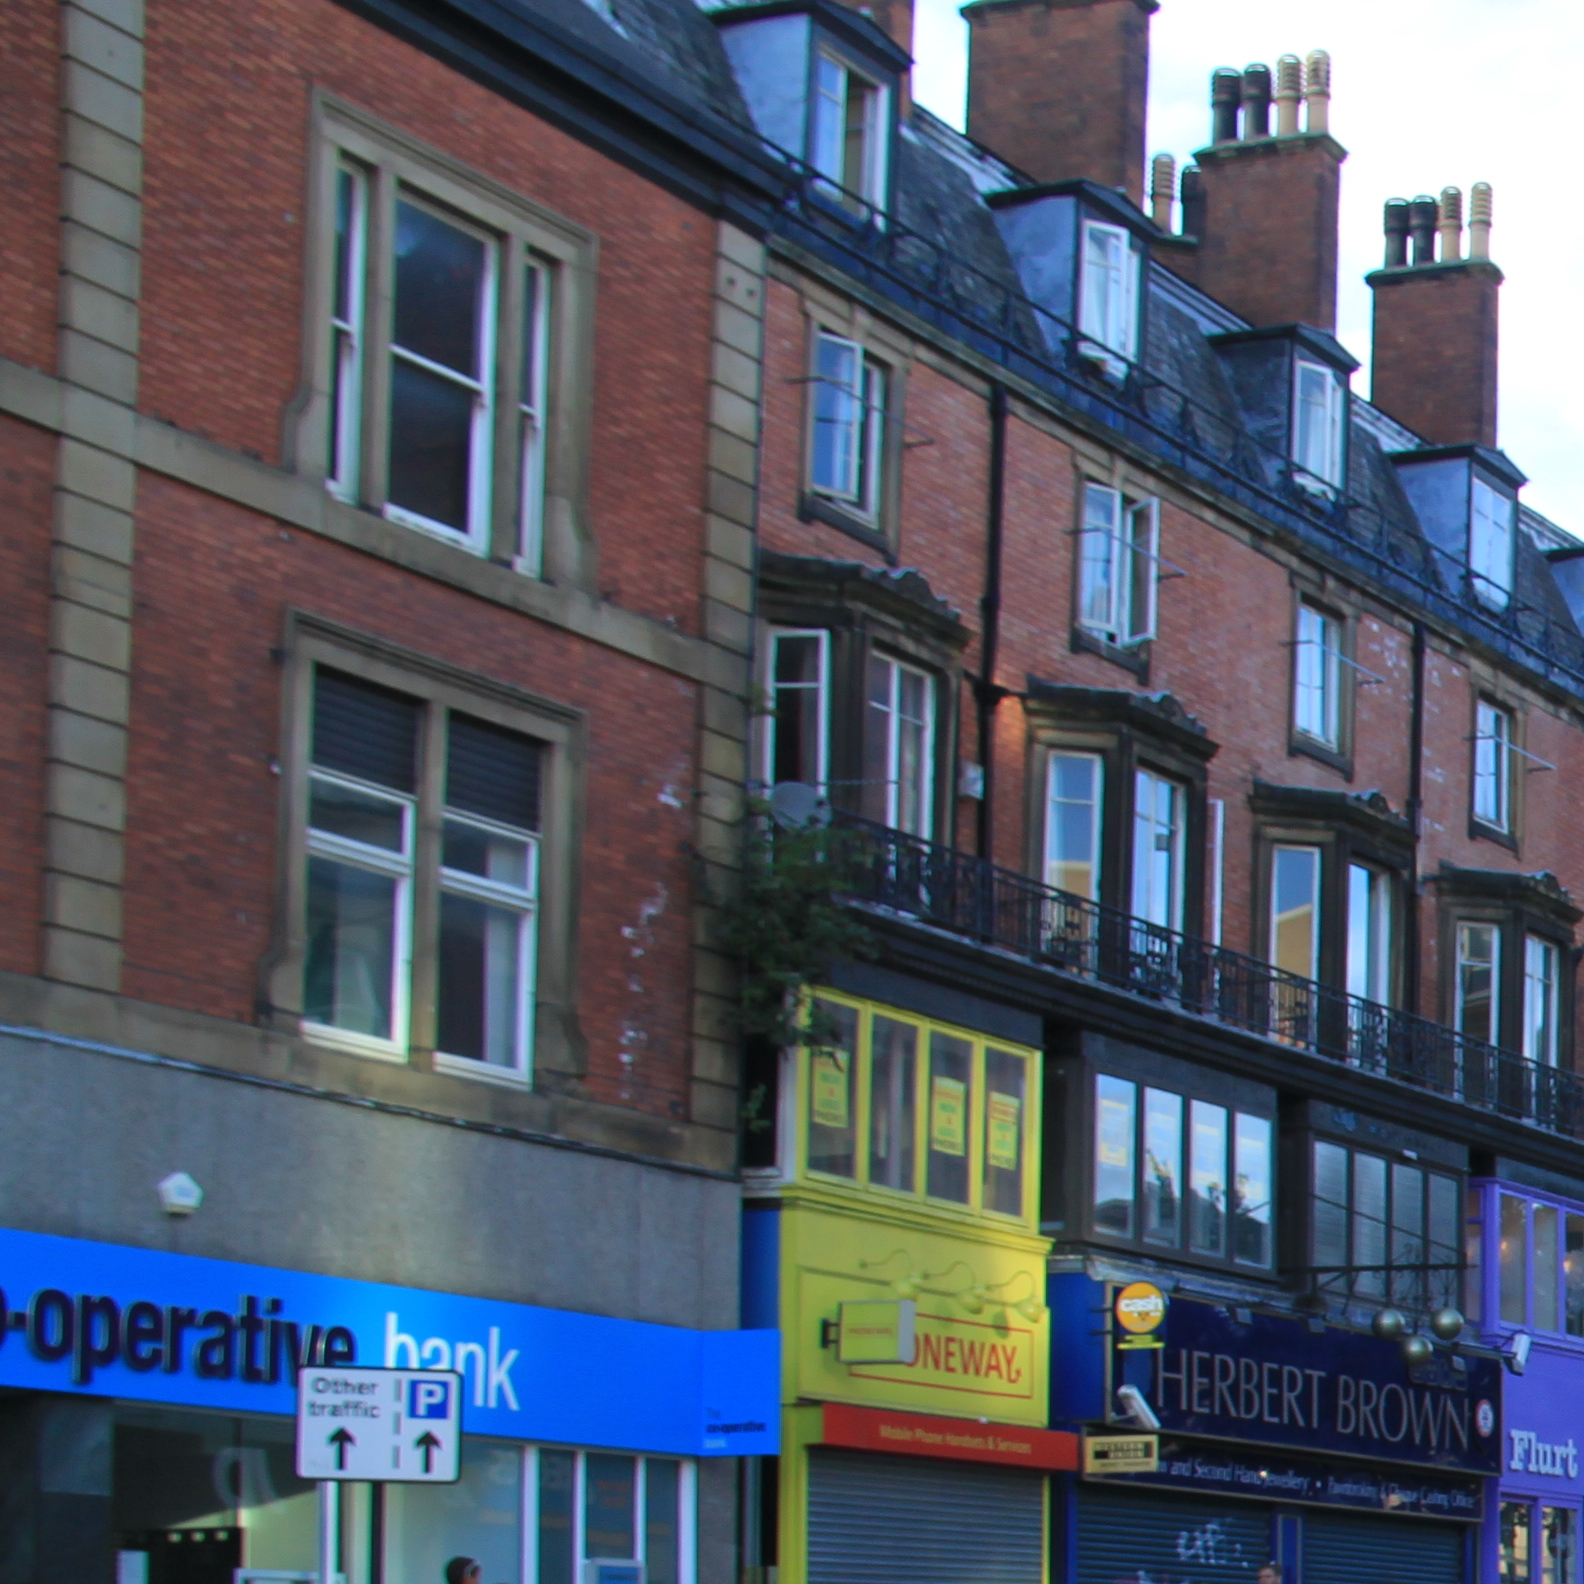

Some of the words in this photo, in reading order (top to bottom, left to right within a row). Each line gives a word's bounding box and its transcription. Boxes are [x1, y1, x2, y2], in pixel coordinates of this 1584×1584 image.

[0, 1284, 358, 1386] -operative
[310, 1377, 379, 1395] Other
[415, 1382, 445, 1417] P
[1156, 1348, 1327, 1429] HERBERT
[1336, 1375, 1470, 1450] BROWN
[307, 1400, 381, 1418] traffic
[1169, 1458, 1193, 1477] and
[1193, 1459, 1233, 1481] Second
[1509, 1428, 1579, 1479] Flurt
